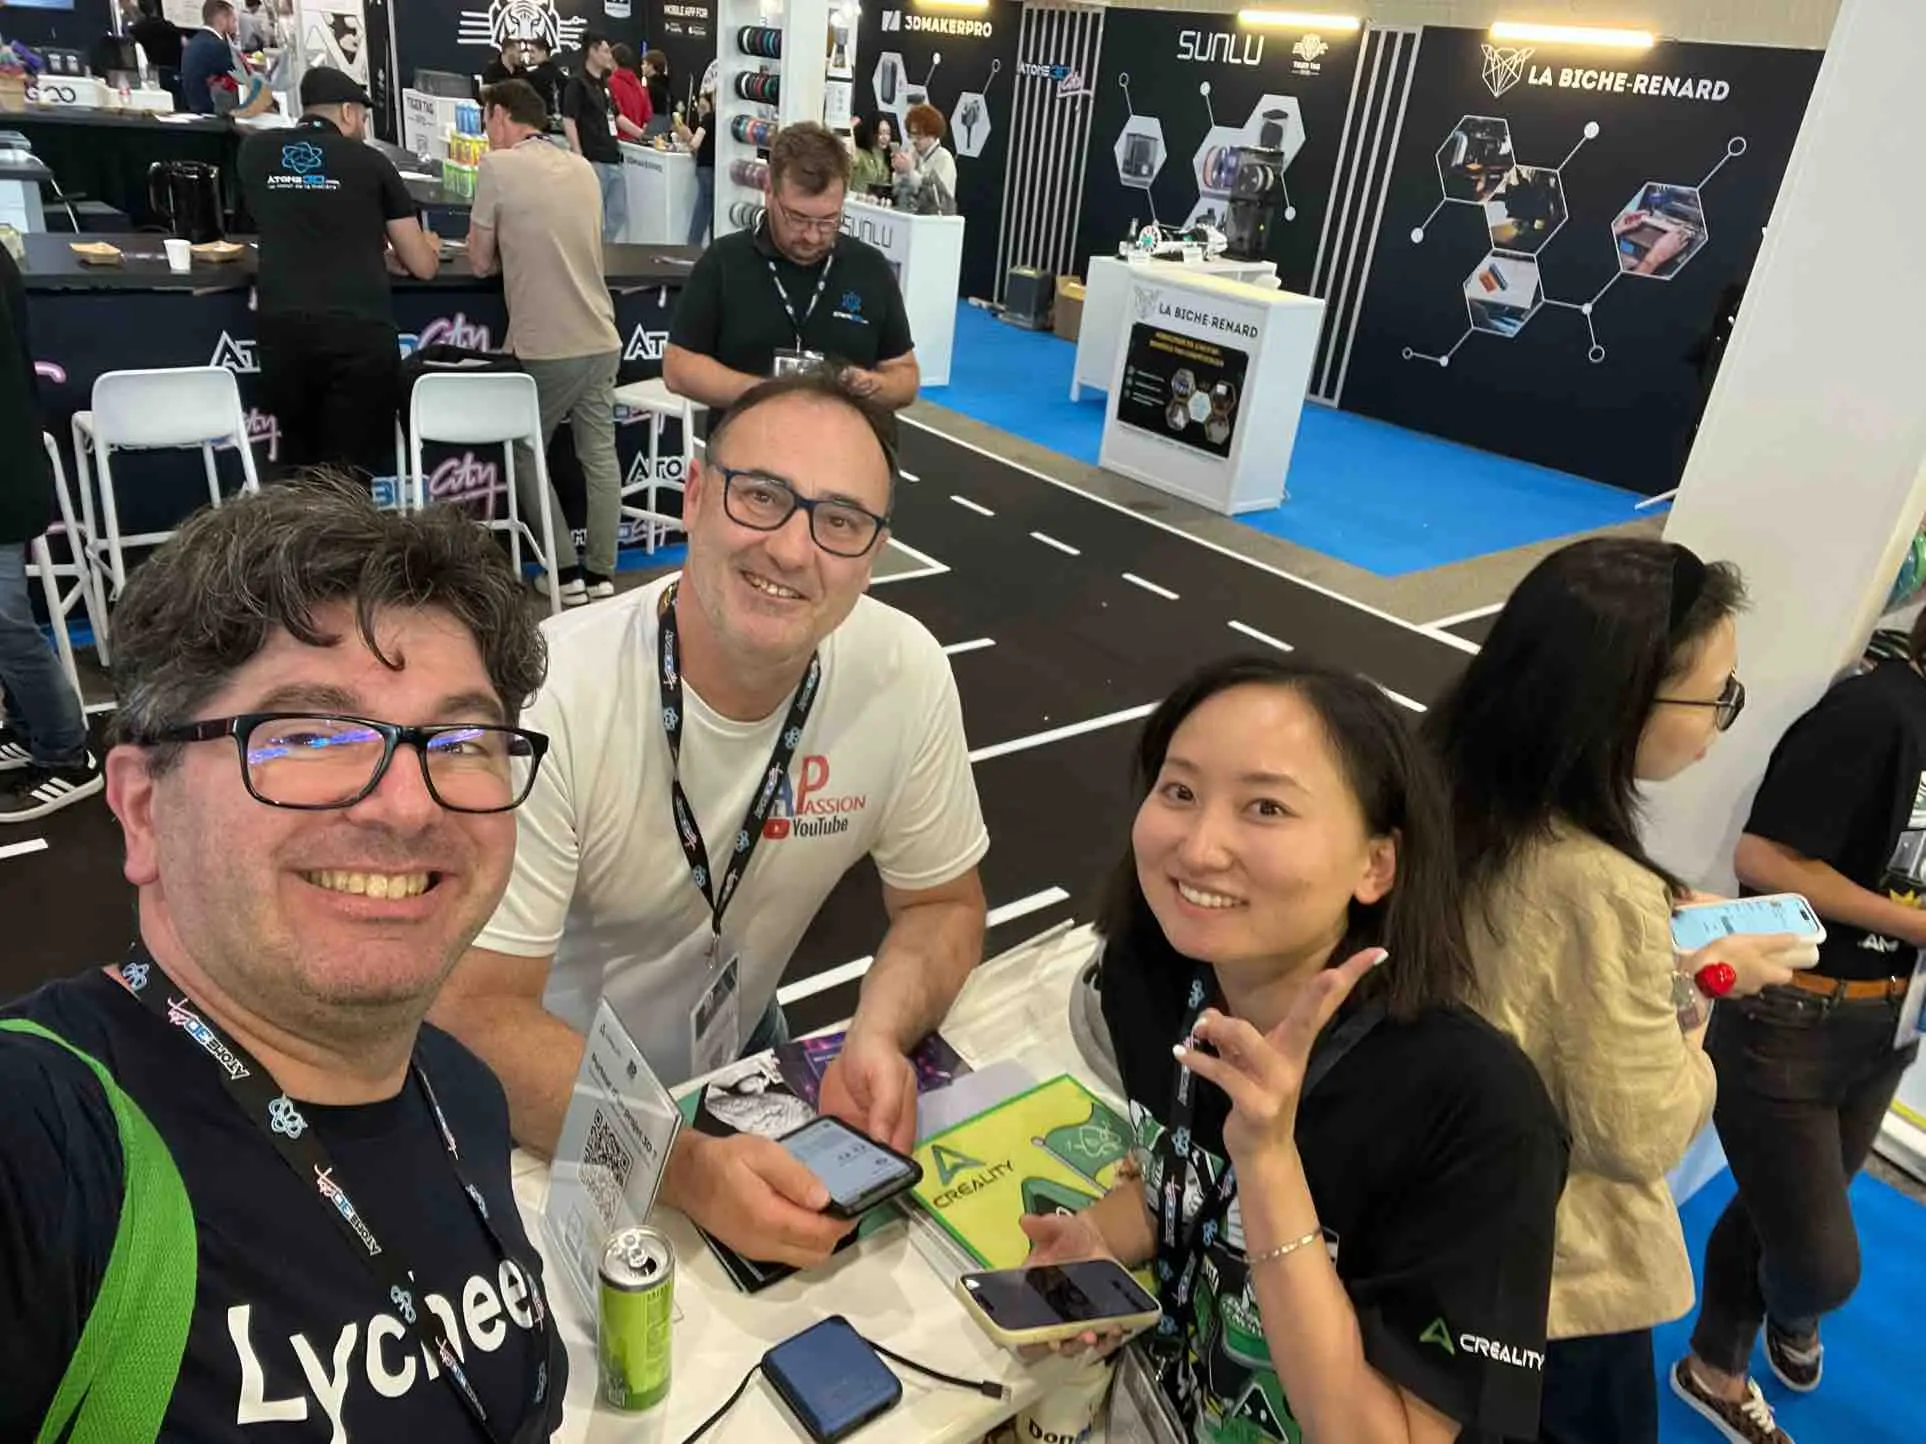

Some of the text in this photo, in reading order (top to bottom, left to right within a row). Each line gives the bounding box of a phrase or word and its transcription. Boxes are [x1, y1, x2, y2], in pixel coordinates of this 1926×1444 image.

[904, 15, 993, 37] 3DMAKERPRO
[1177, 31, 1264, 65] SUNLU
[1528, 65, 1730, 101] LA BICHE-RENARD
[1159, 303, 1258, 338] LA BICHE-RENARD
[793, 816, 849, 838] YouTube
[933, 1159, 1014, 1209] CREALITY
[1459, 1333, 1545, 1372] CREALITY
